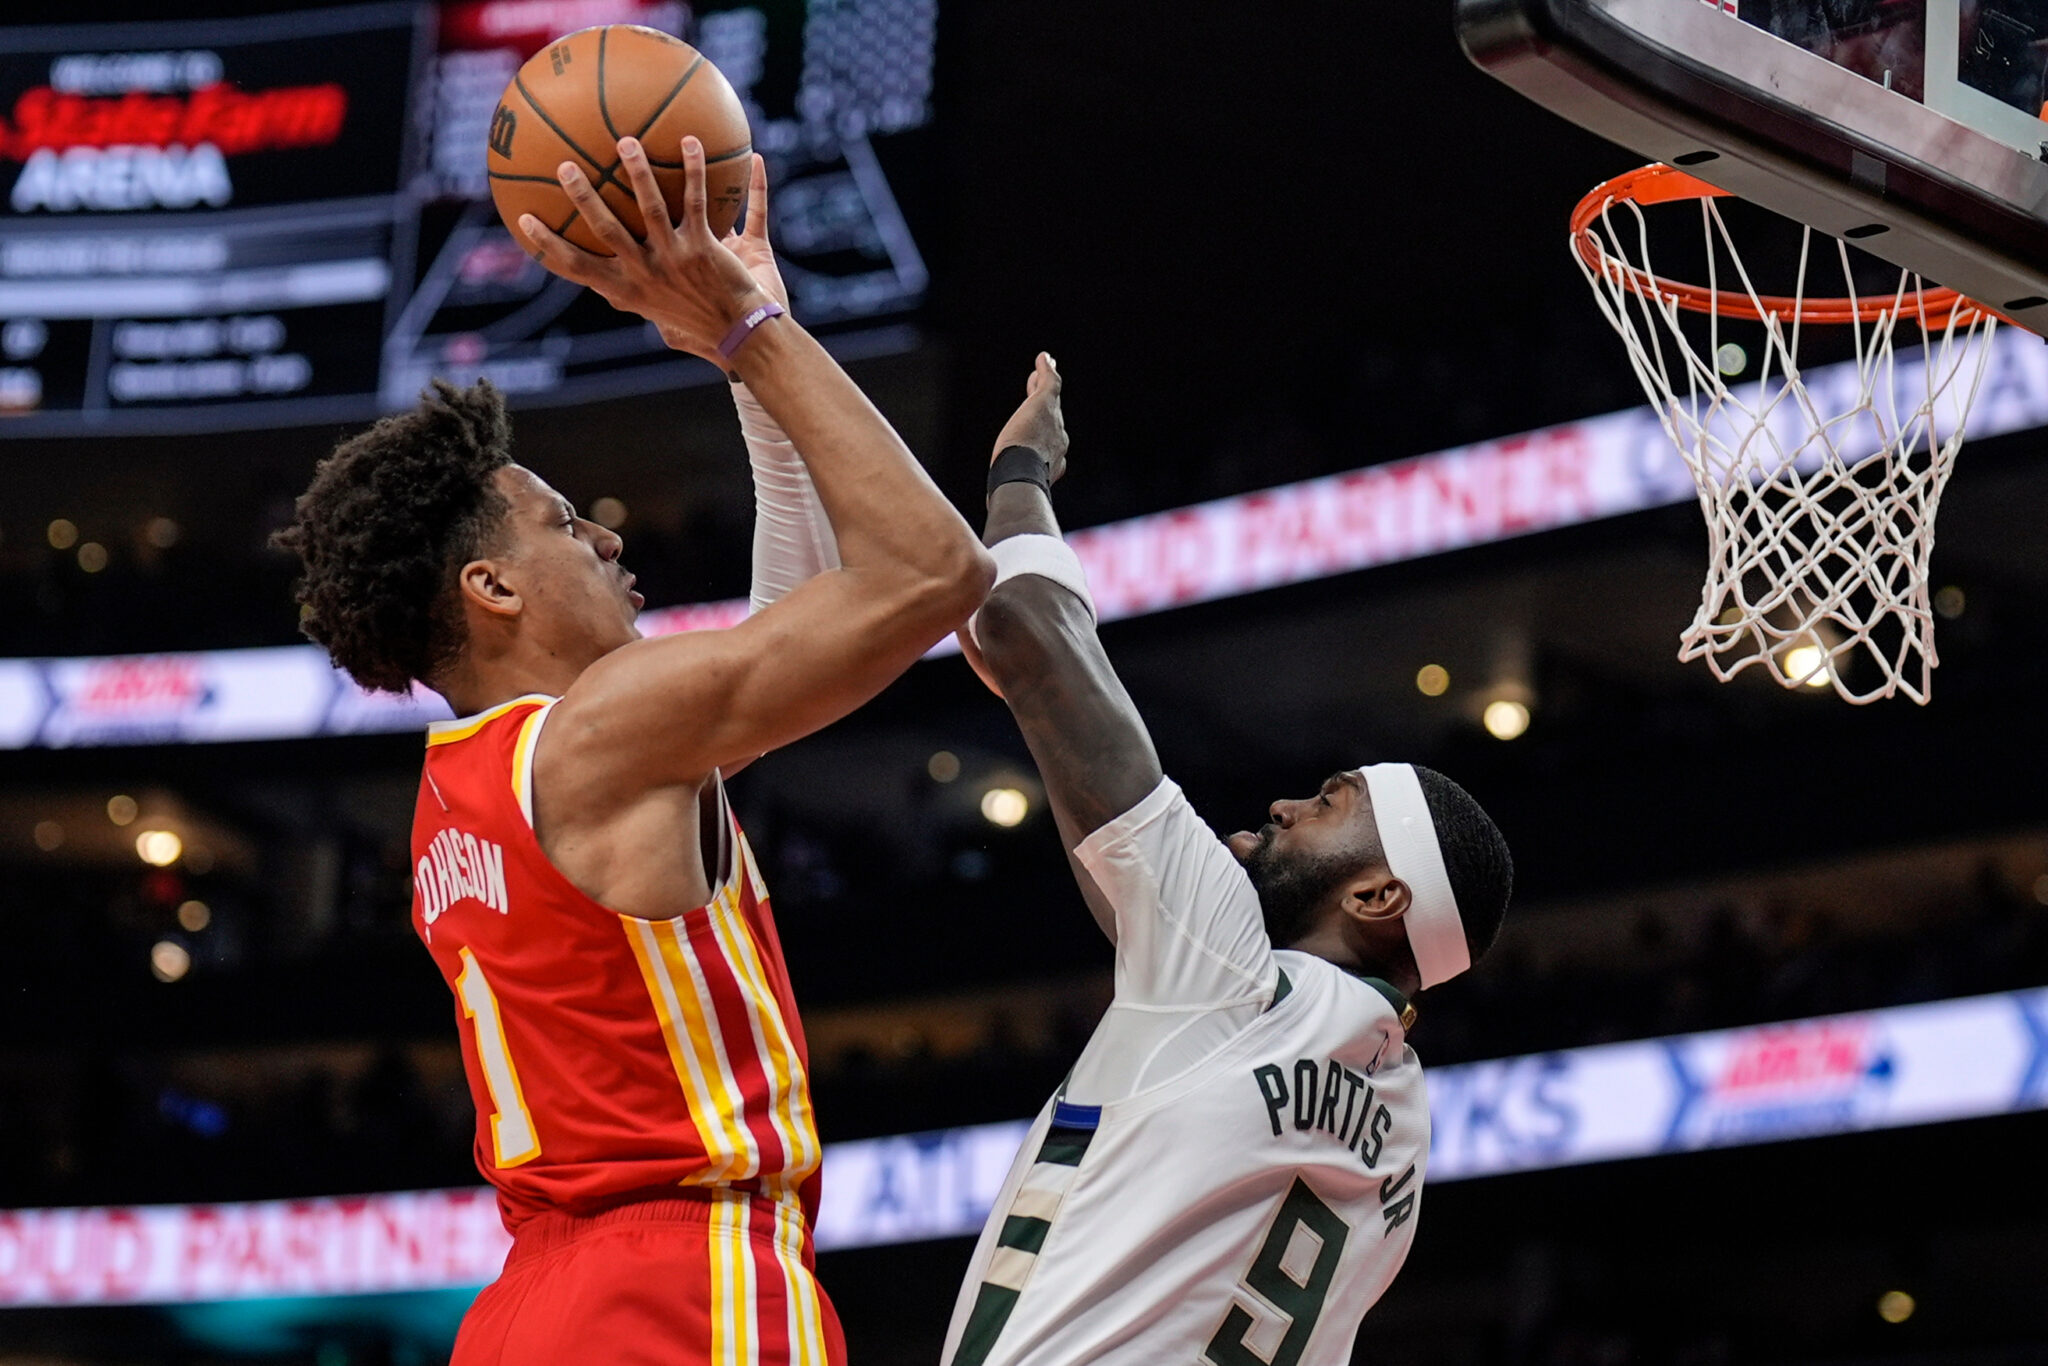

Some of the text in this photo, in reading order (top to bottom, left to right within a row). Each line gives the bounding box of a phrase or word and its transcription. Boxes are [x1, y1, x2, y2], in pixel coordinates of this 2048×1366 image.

[9, 143, 233, 211] ARENA
[1236, 425, 1590, 588] PARTNER
[455, 946, 541, 1168] 1
[1253, 1058, 1416, 1239] PORTIS JR
[1200, 1173, 1352, 1366] 9
